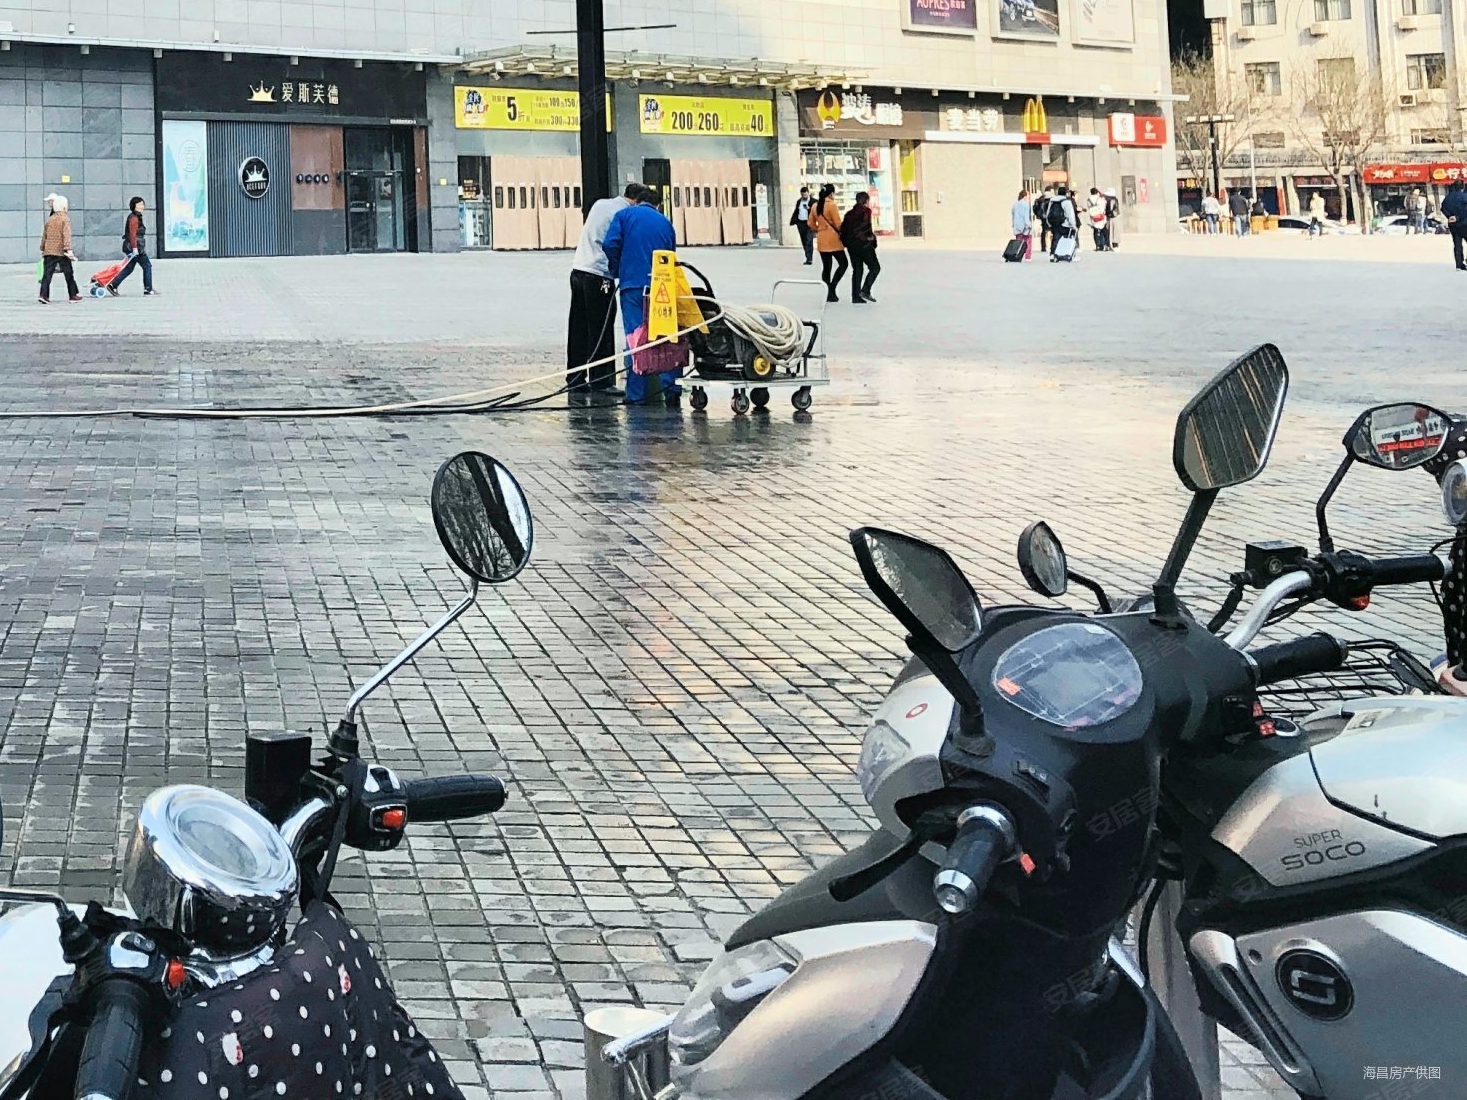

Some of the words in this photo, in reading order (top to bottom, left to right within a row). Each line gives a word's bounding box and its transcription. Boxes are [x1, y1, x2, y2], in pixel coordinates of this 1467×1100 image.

[947, 108, 998, 131] 麦当劳
[1294, 829, 1343, 849] SUPER
[1281, 841, 1365, 871] SOCO
